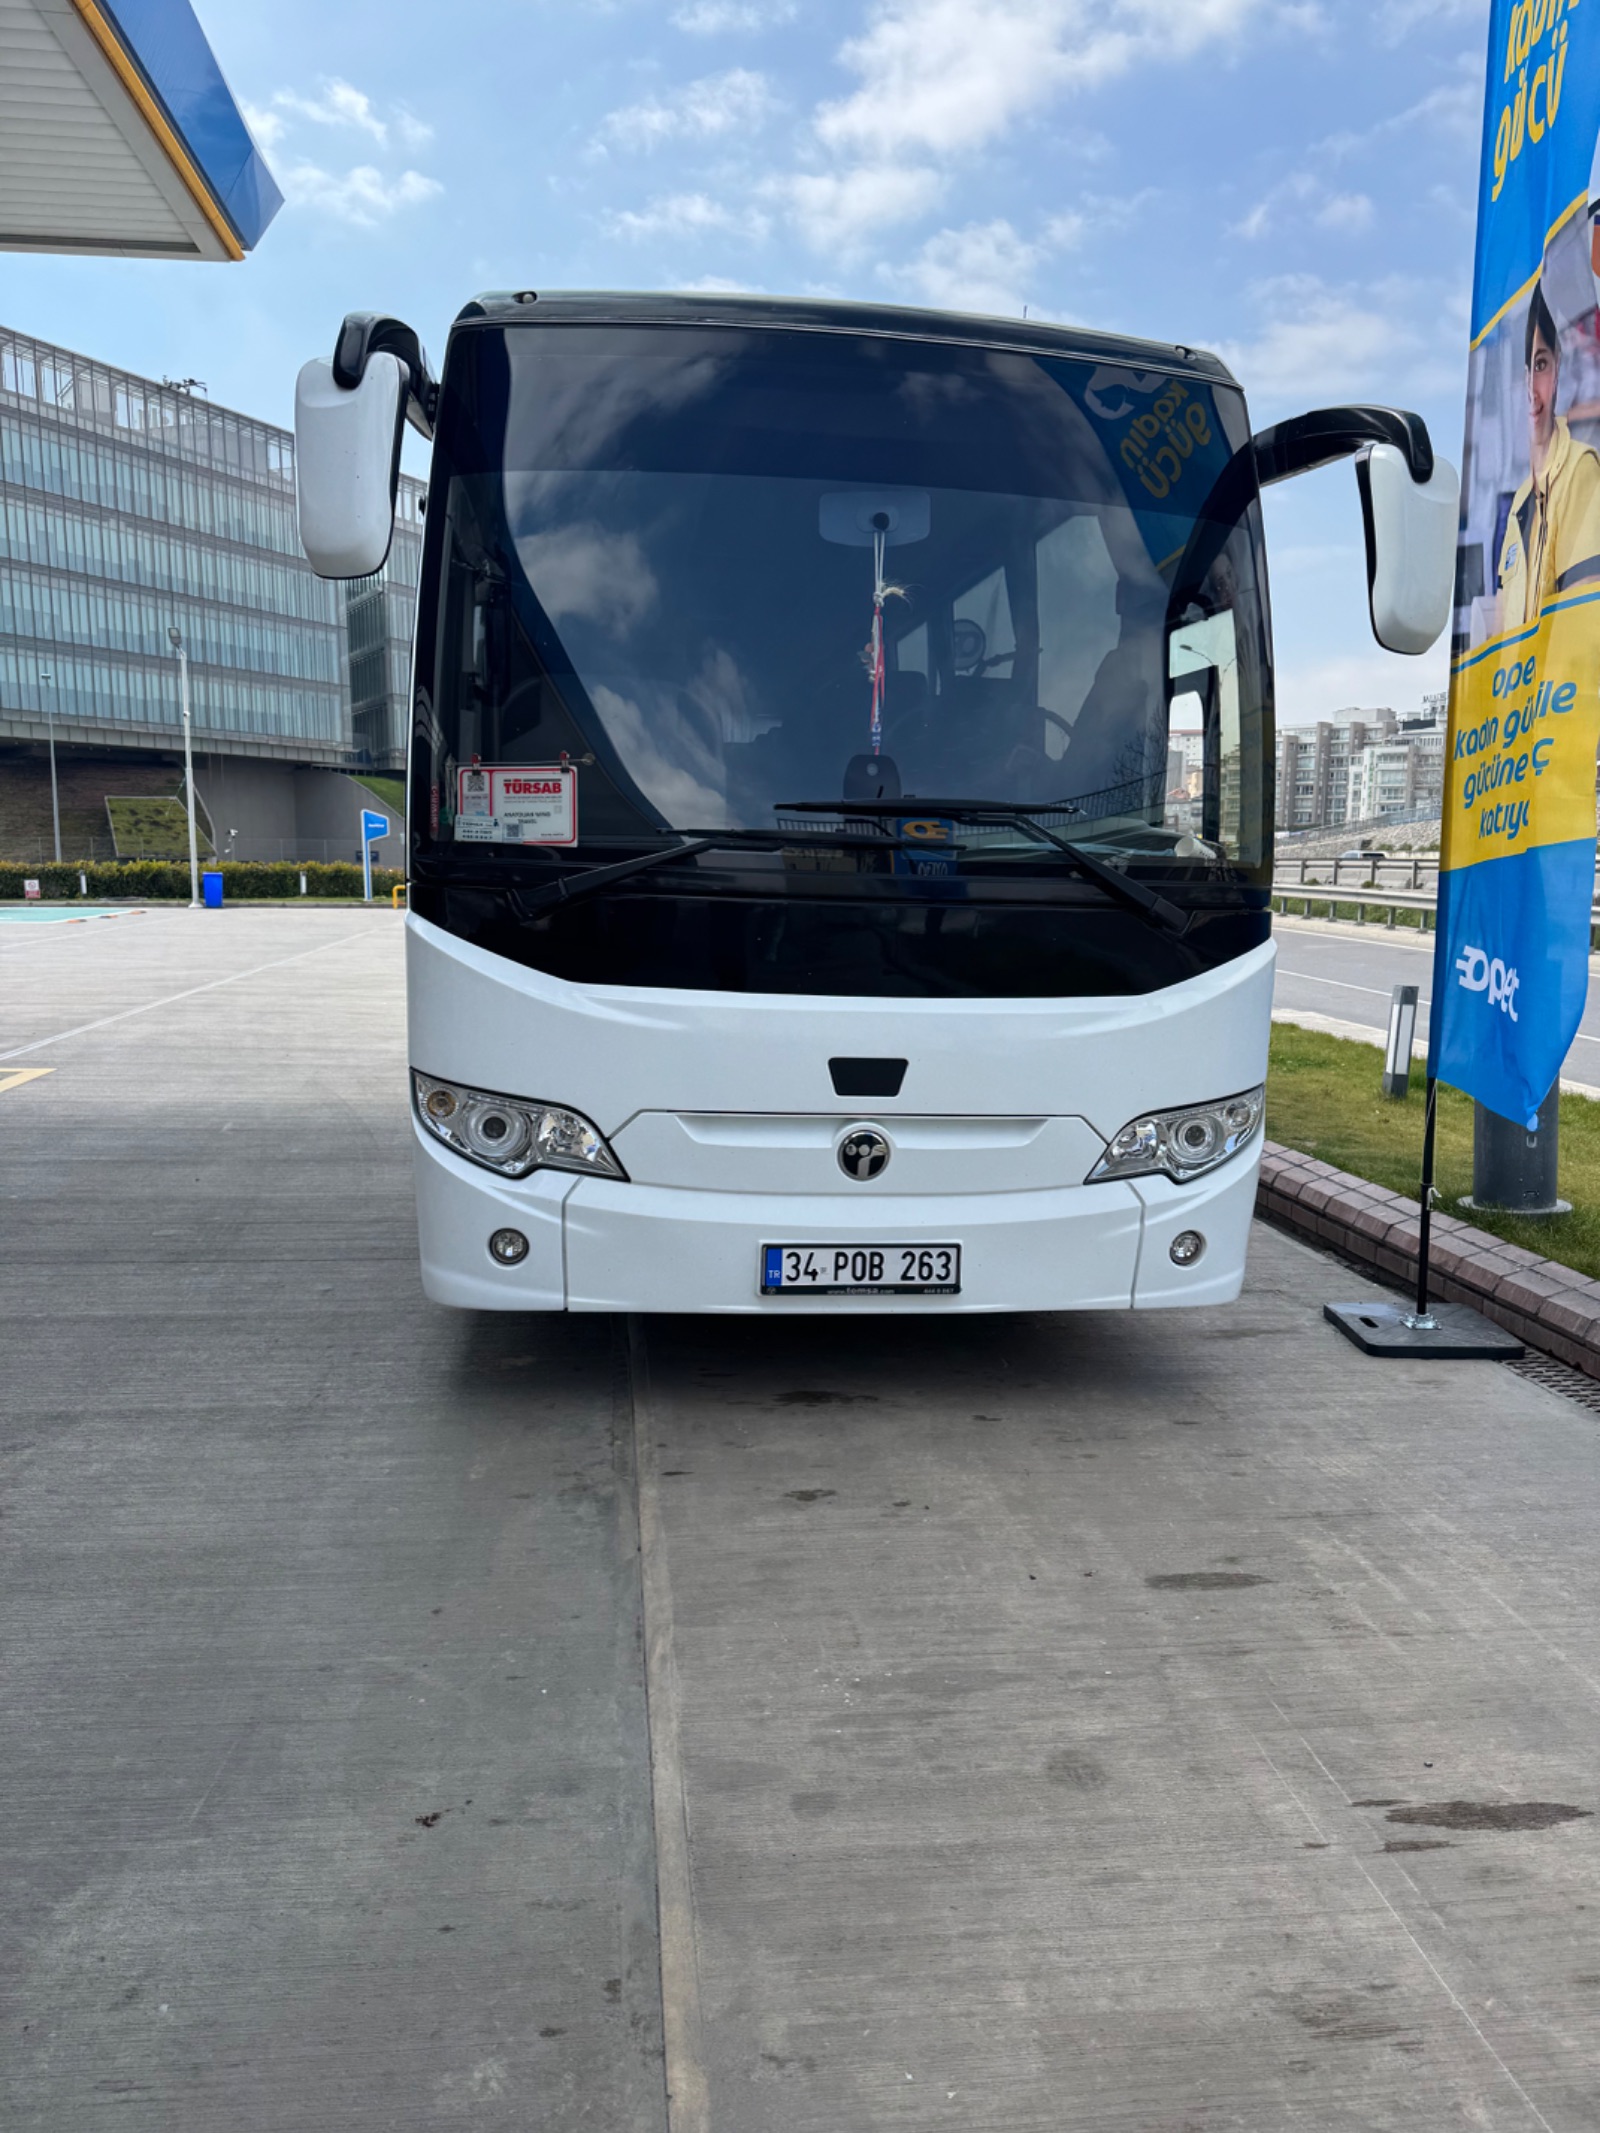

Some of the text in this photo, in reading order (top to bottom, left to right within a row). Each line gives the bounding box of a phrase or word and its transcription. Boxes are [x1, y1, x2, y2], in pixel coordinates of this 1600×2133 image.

[1491, 20, 1568, 202] gücü
[1492, 655, 1536, 699] ope
[503, 778, 562, 794] TÜRSAB
[1463, 752, 1529, 810] gücüne
[768, 1250, 952, 1282] TR 34 POB 263
